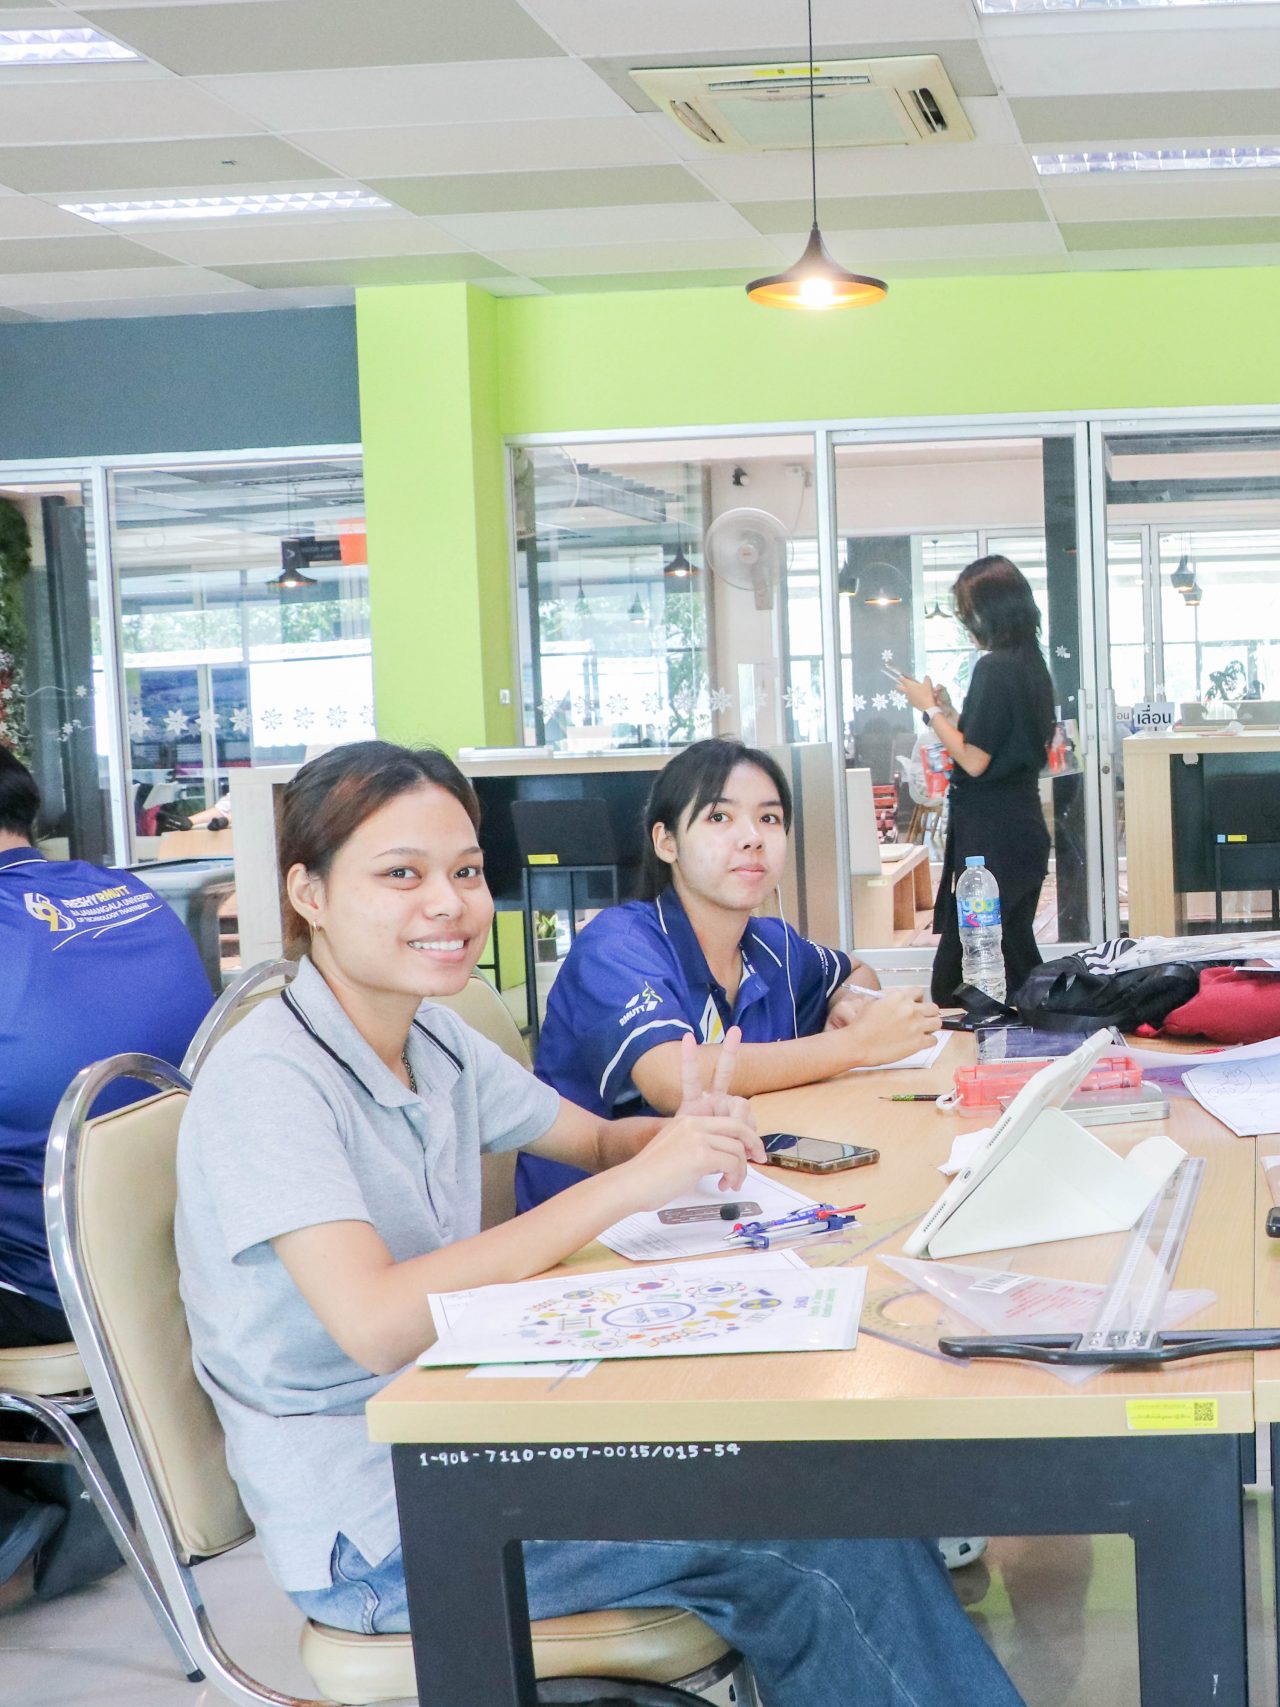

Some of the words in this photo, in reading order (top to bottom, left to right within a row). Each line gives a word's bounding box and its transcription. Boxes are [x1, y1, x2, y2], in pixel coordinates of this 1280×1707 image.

[1137, 704, 1172, 725] เลื่อน
[618, 1004, 646, 1027] RMUTT
